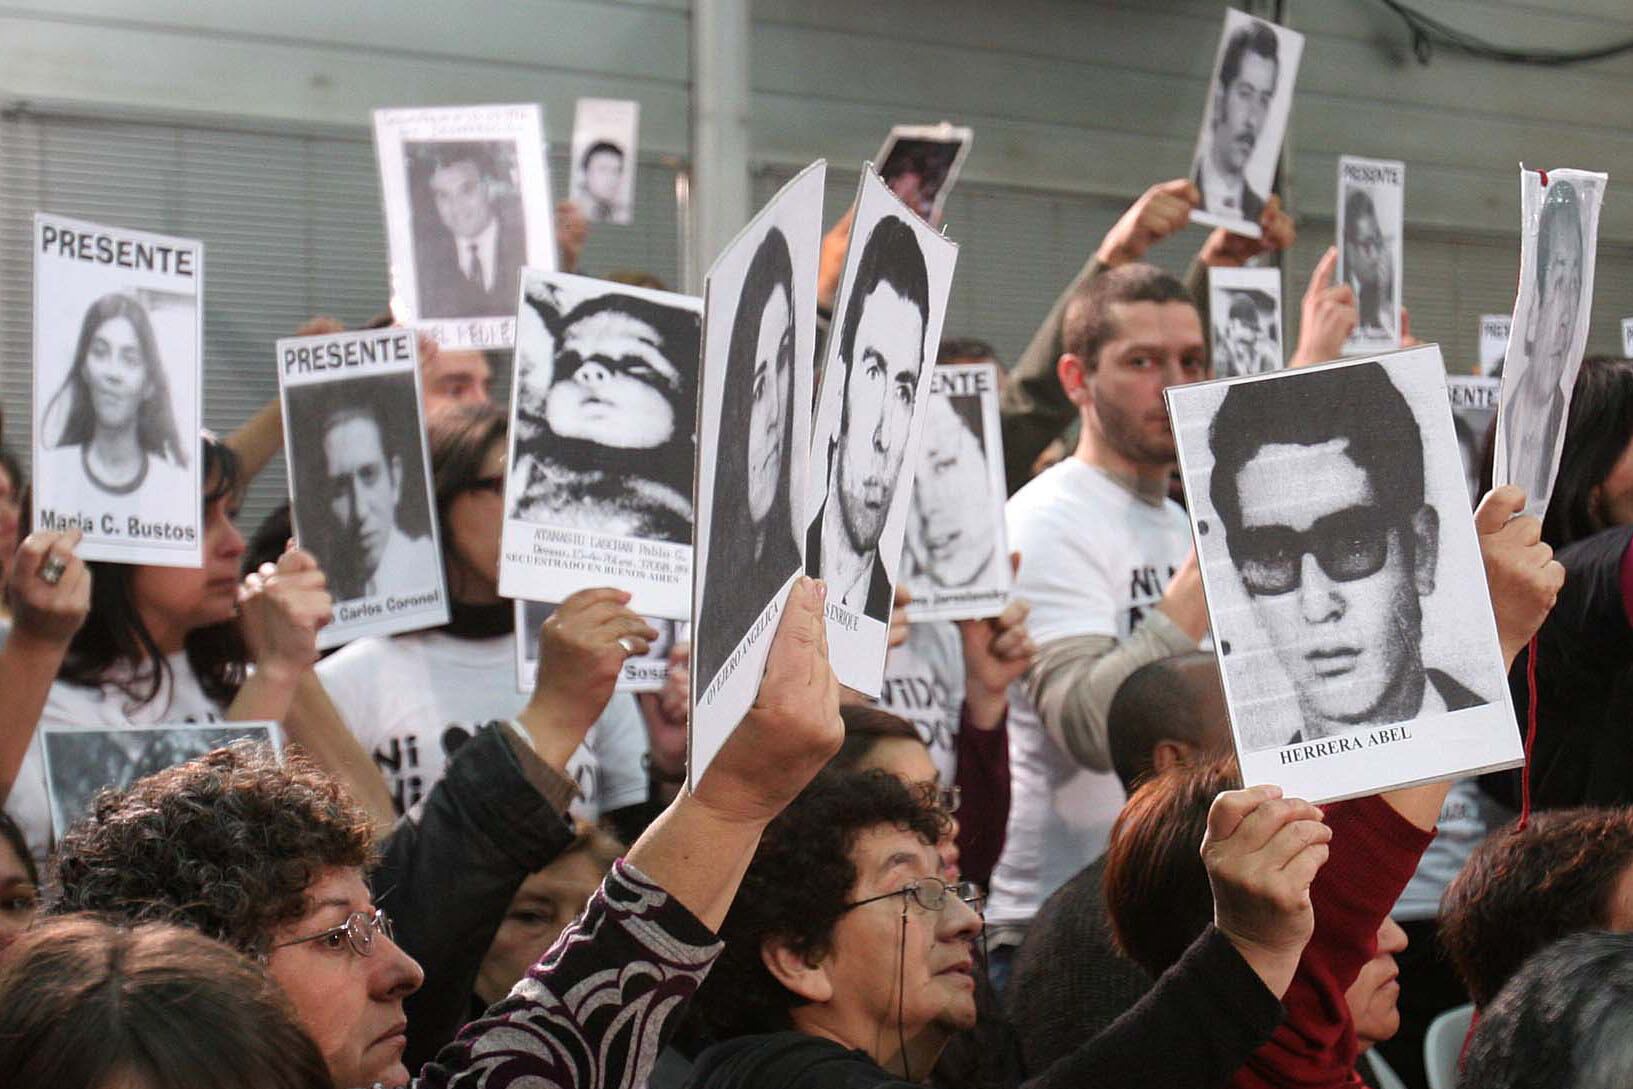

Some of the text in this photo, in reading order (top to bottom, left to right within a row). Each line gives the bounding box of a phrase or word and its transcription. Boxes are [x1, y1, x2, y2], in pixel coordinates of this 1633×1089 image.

[42, 225, 193, 277] PRESENTE
[285, 335, 409, 374] PRESENTE
[101, 514, 121, 536] C.
[127, 516, 196, 541] Bustos
[604, 564, 646, 580] BUENOS
[648, 573, 680, 584] AIRES
[339, 603, 383, 621] Carlos
[386, 590, 439, 612] Coronel
[829, 603, 860, 631] ENRIQUE
[706, 600, 779, 705] OVEJERO ANGELICA
[1280, 726, 1412, 765] HERRERA ABEL
